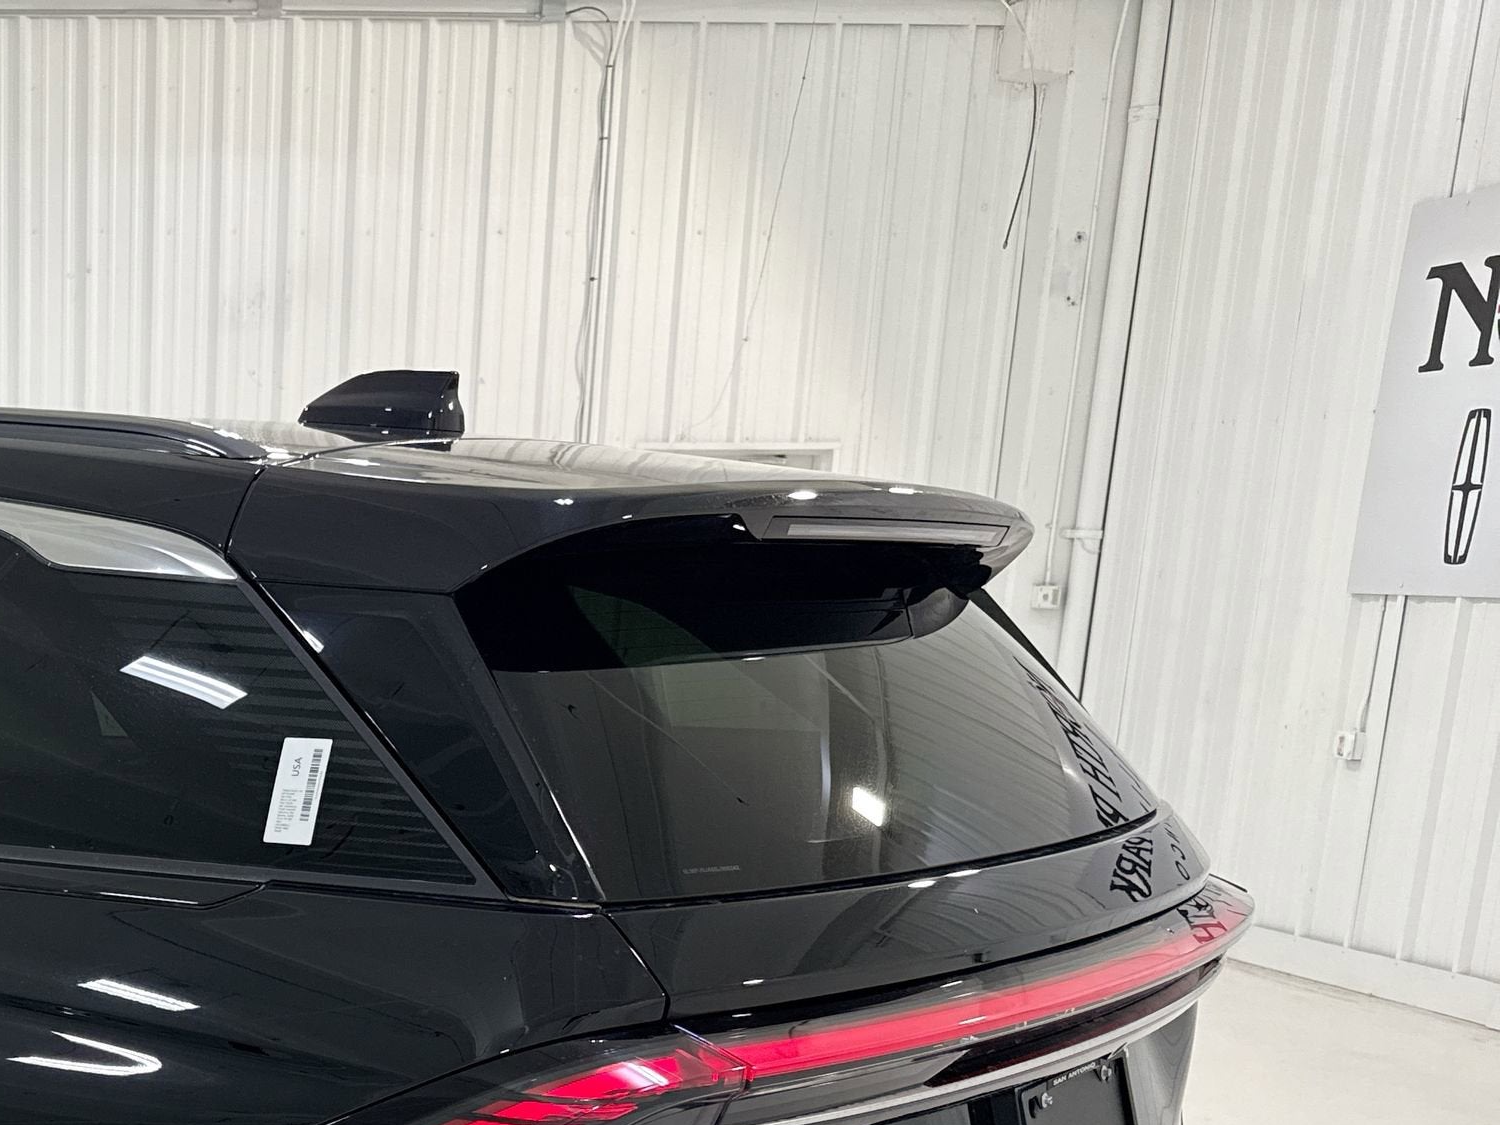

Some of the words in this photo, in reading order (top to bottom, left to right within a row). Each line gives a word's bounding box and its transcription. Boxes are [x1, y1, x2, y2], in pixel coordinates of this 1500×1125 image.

[1418, 254, 1500, 373] N
[291, 756, 303, 777] USA
[1053, 1075, 1067, 1086] SAN
[1068, 1061, 1096, 1079] ANTONIO
